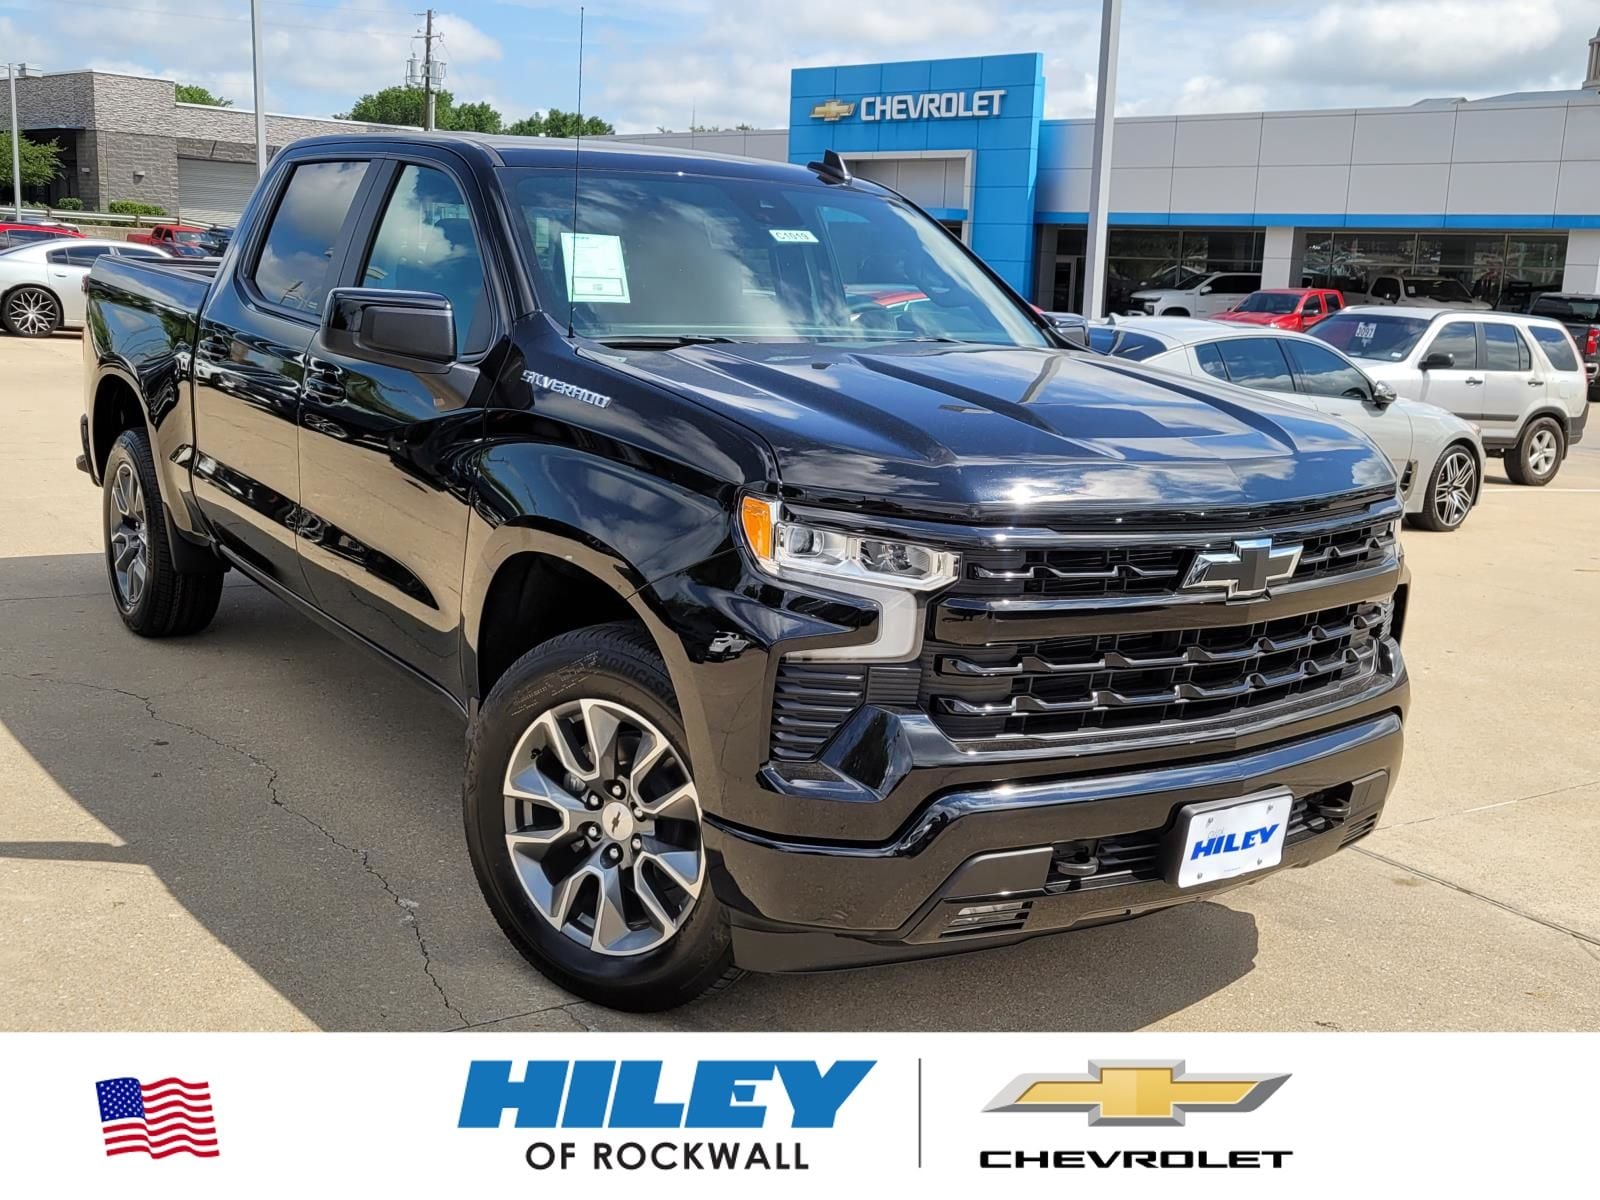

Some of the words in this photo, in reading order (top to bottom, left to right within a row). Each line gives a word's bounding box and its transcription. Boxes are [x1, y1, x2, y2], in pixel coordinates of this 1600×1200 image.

[860, 89, 1007, 121] CHEVROLET
[520, 369, 612, 408] SILVERADO
[1190, 823, 1280, 861] HILEY
